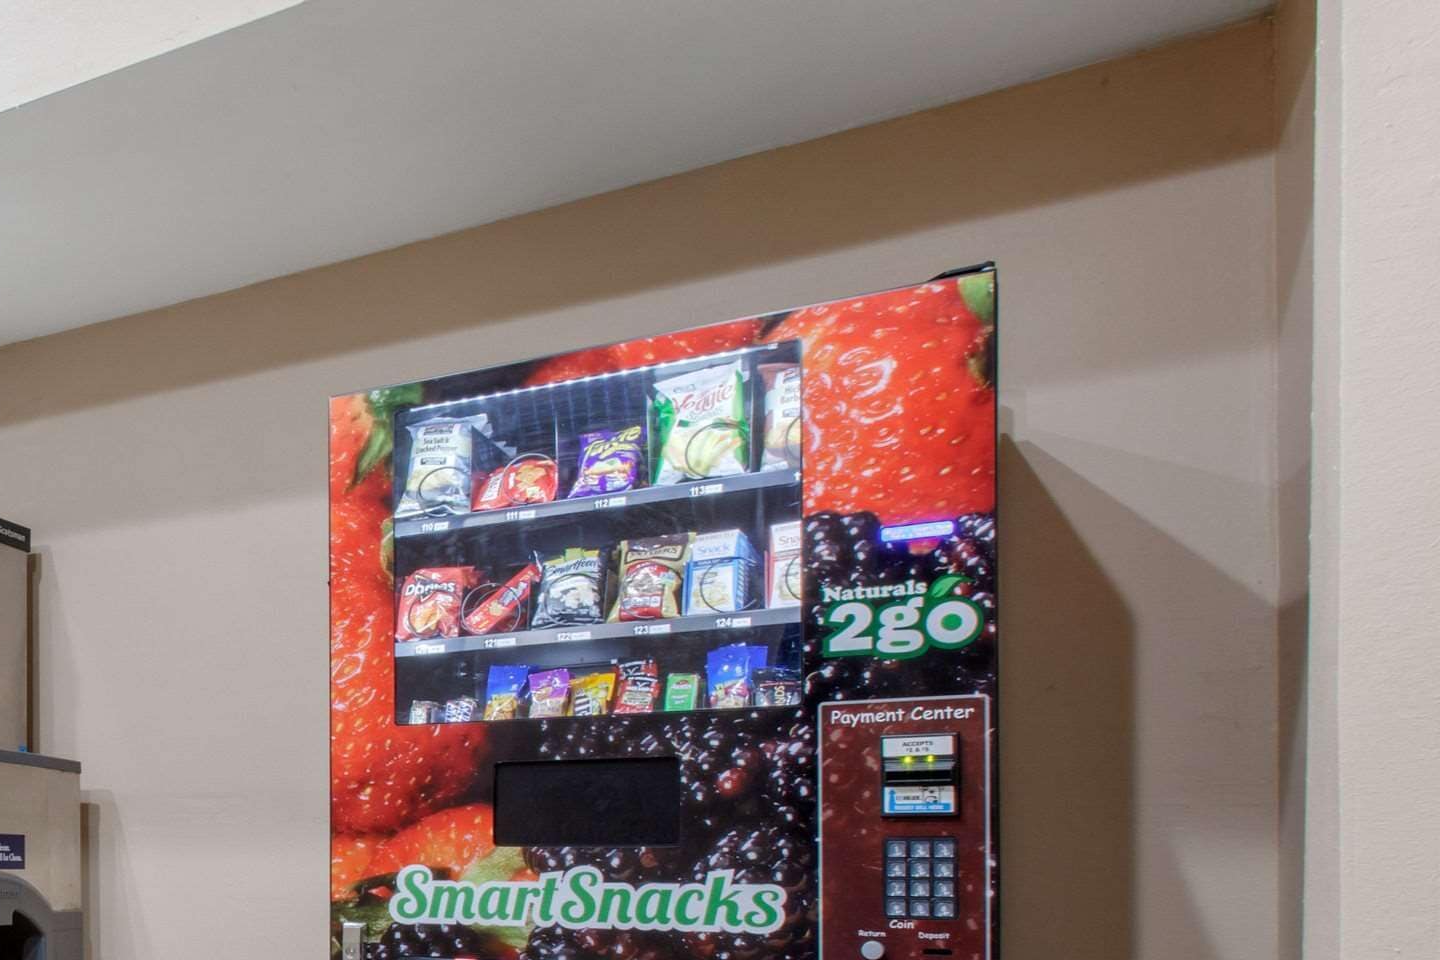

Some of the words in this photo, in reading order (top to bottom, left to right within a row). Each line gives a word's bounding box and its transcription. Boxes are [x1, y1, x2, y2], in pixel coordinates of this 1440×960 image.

[404, 581, 456, 598] Doritos
[822, 579, 928, 602] Naturals
[830, 708, 905, 727] Payment
[910, 705, 975, 721] Center
[393, 866, 782, 930] SmartSnacks
[889, 919, 915, 929] Coin
[858, 929, 887, 938] Return
[918, 931, 950, 940] Deposit
